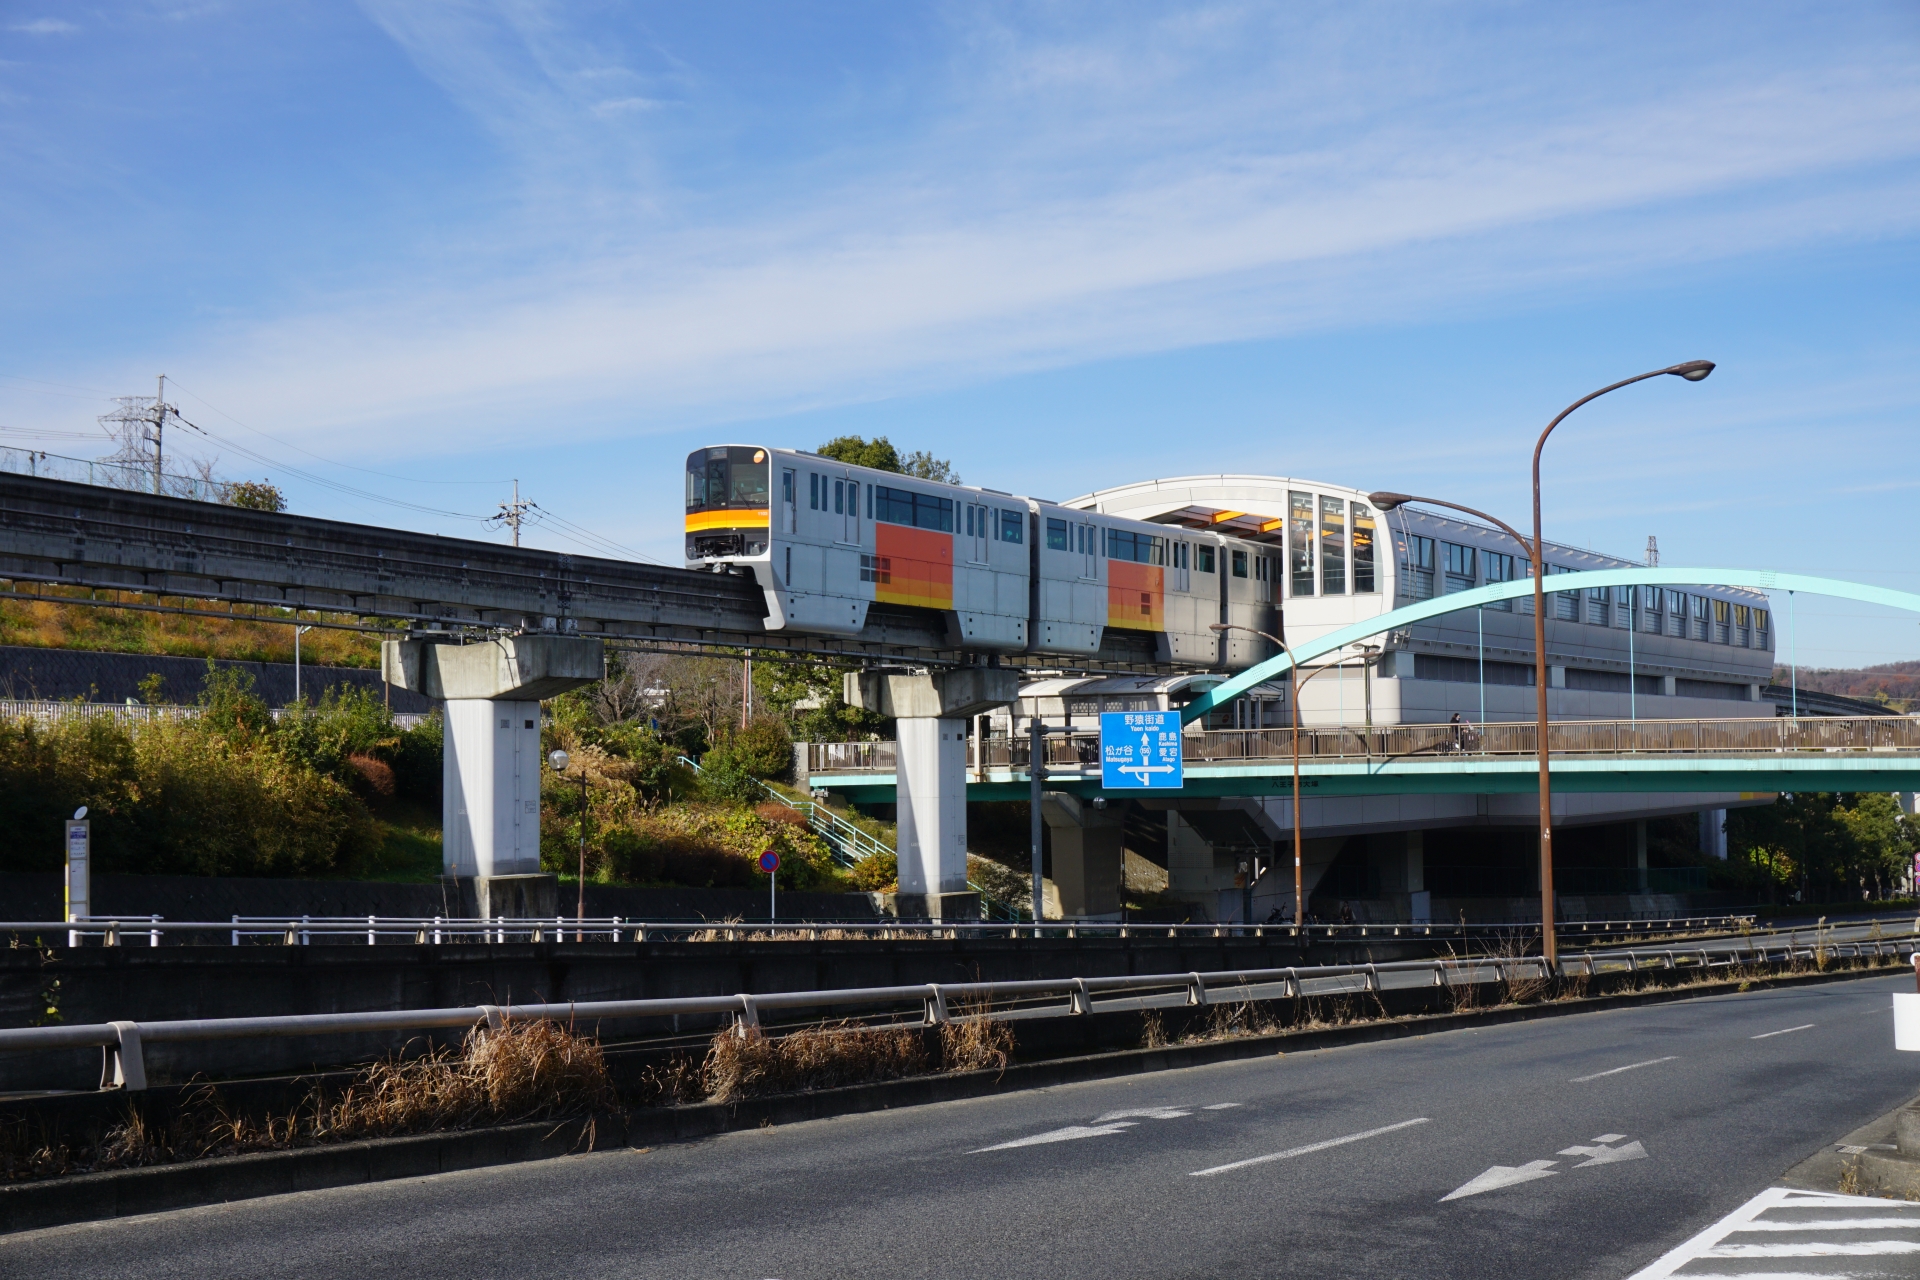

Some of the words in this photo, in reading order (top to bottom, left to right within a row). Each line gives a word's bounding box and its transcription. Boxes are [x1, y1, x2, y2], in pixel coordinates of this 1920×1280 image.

[1124, 714, 1165, 725] 野猿街道
[1105, 745, 1133, 756] 松が谷
